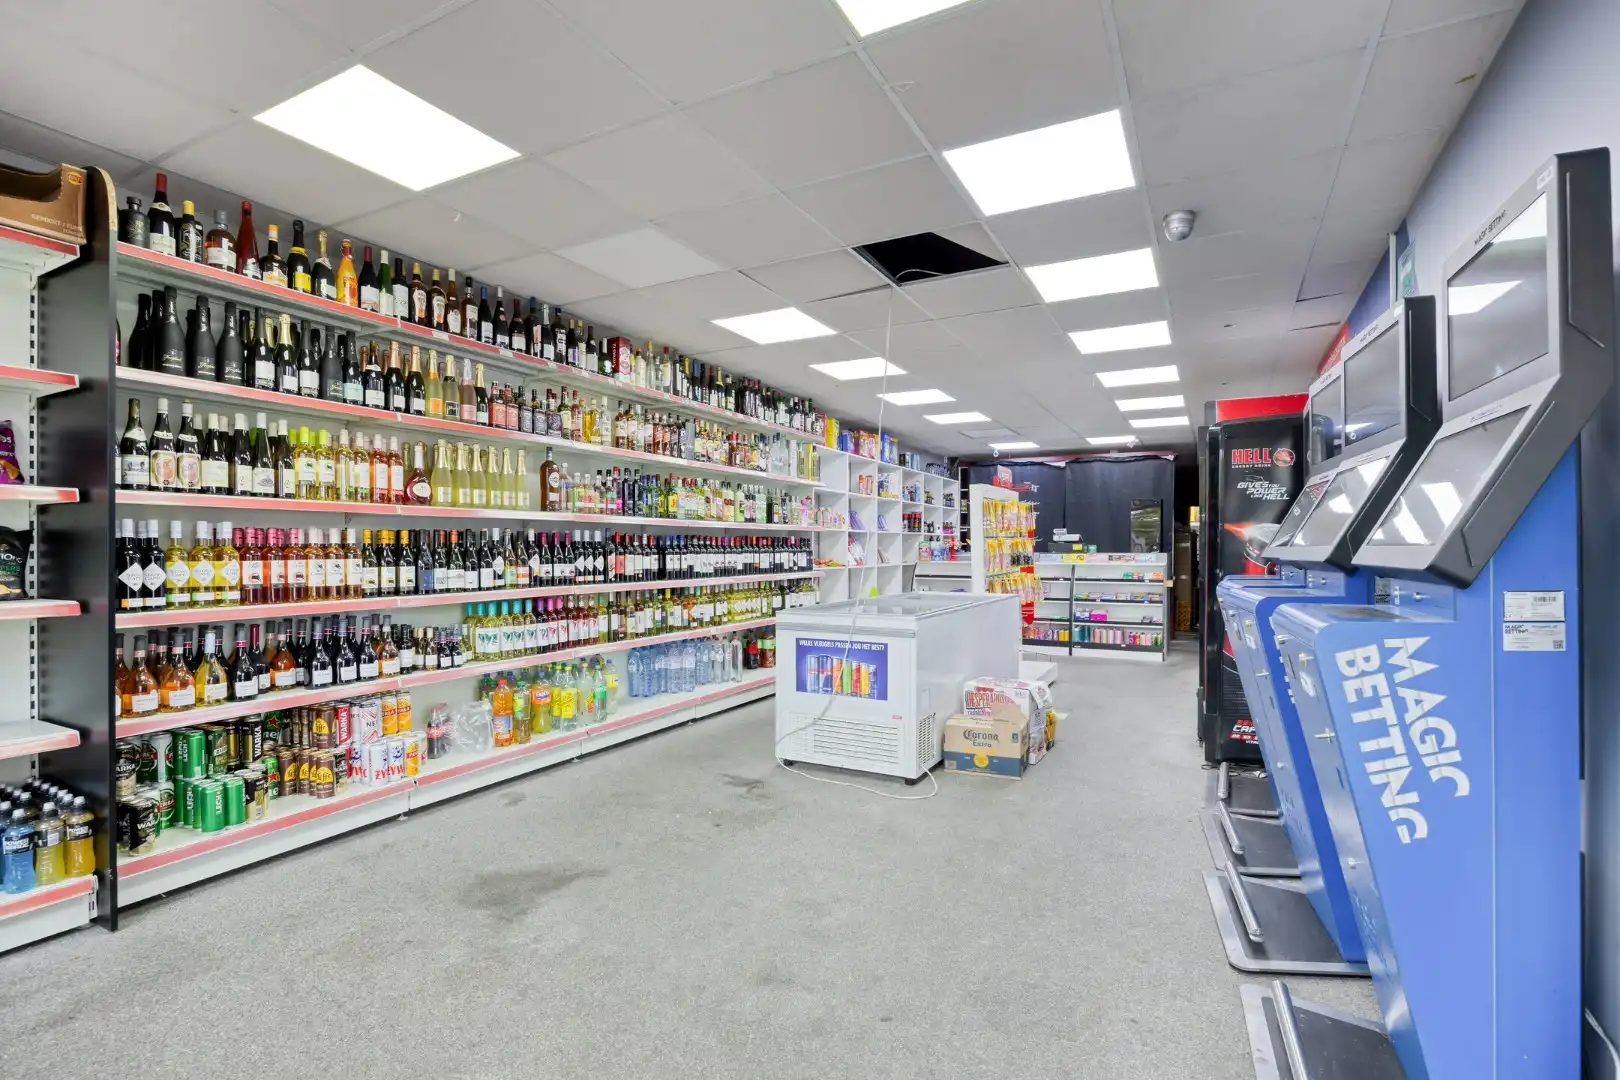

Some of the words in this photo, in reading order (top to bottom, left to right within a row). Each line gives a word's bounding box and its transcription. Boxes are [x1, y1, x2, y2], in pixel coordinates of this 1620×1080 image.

[1231, 448, 1271, 464] HELL
[1237, 481, 1269, 489] GIVES
[1246, 487, 1286, 495] POWER
[1383, 636, 1471, 797] MAGIC
[340, 711, 348, 740] WARKA
[254, 725, 262, 758] WARKA
[963, 729, 999, 743] Corona
[972, 739, 992, 748] Extra
[1334, 644, 1428, 844] BETTING
[115, 763, 136, 772] ARKA
[215, 790, 223, 814] LECH
